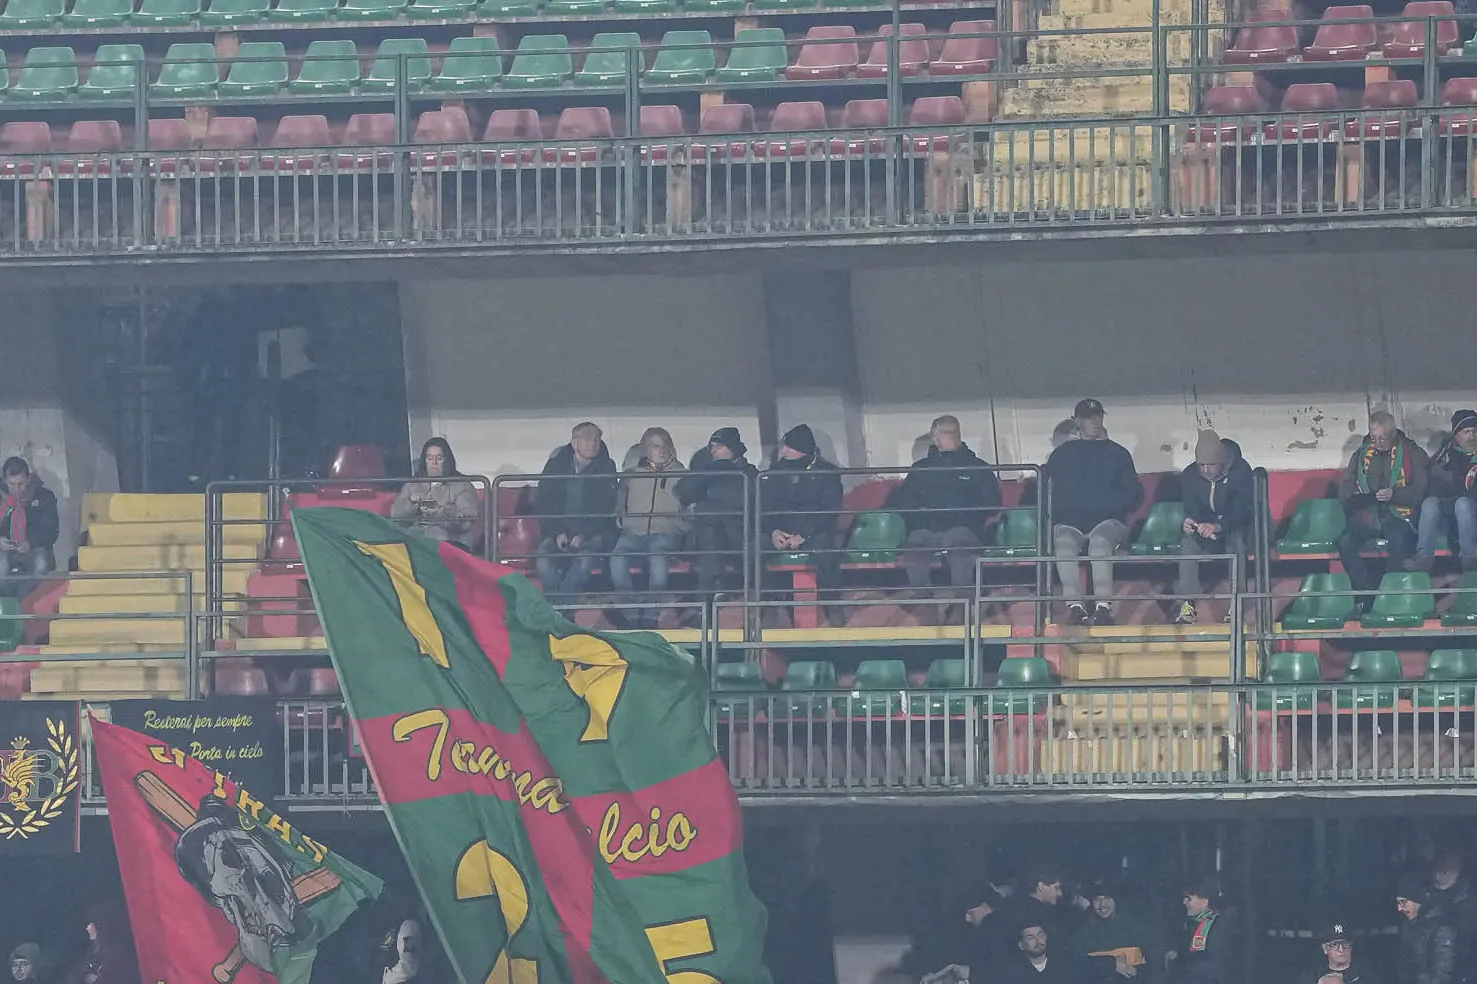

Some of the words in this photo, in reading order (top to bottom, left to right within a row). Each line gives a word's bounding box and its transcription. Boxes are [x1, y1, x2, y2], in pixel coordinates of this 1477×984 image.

[143, 709, 193, 730] Resterai
[193, 714, 212, 733] per
[213, 713, 253, 733] sempre
[225, 745, 236, 759] in
[239, 740, 264, 760] cielo
